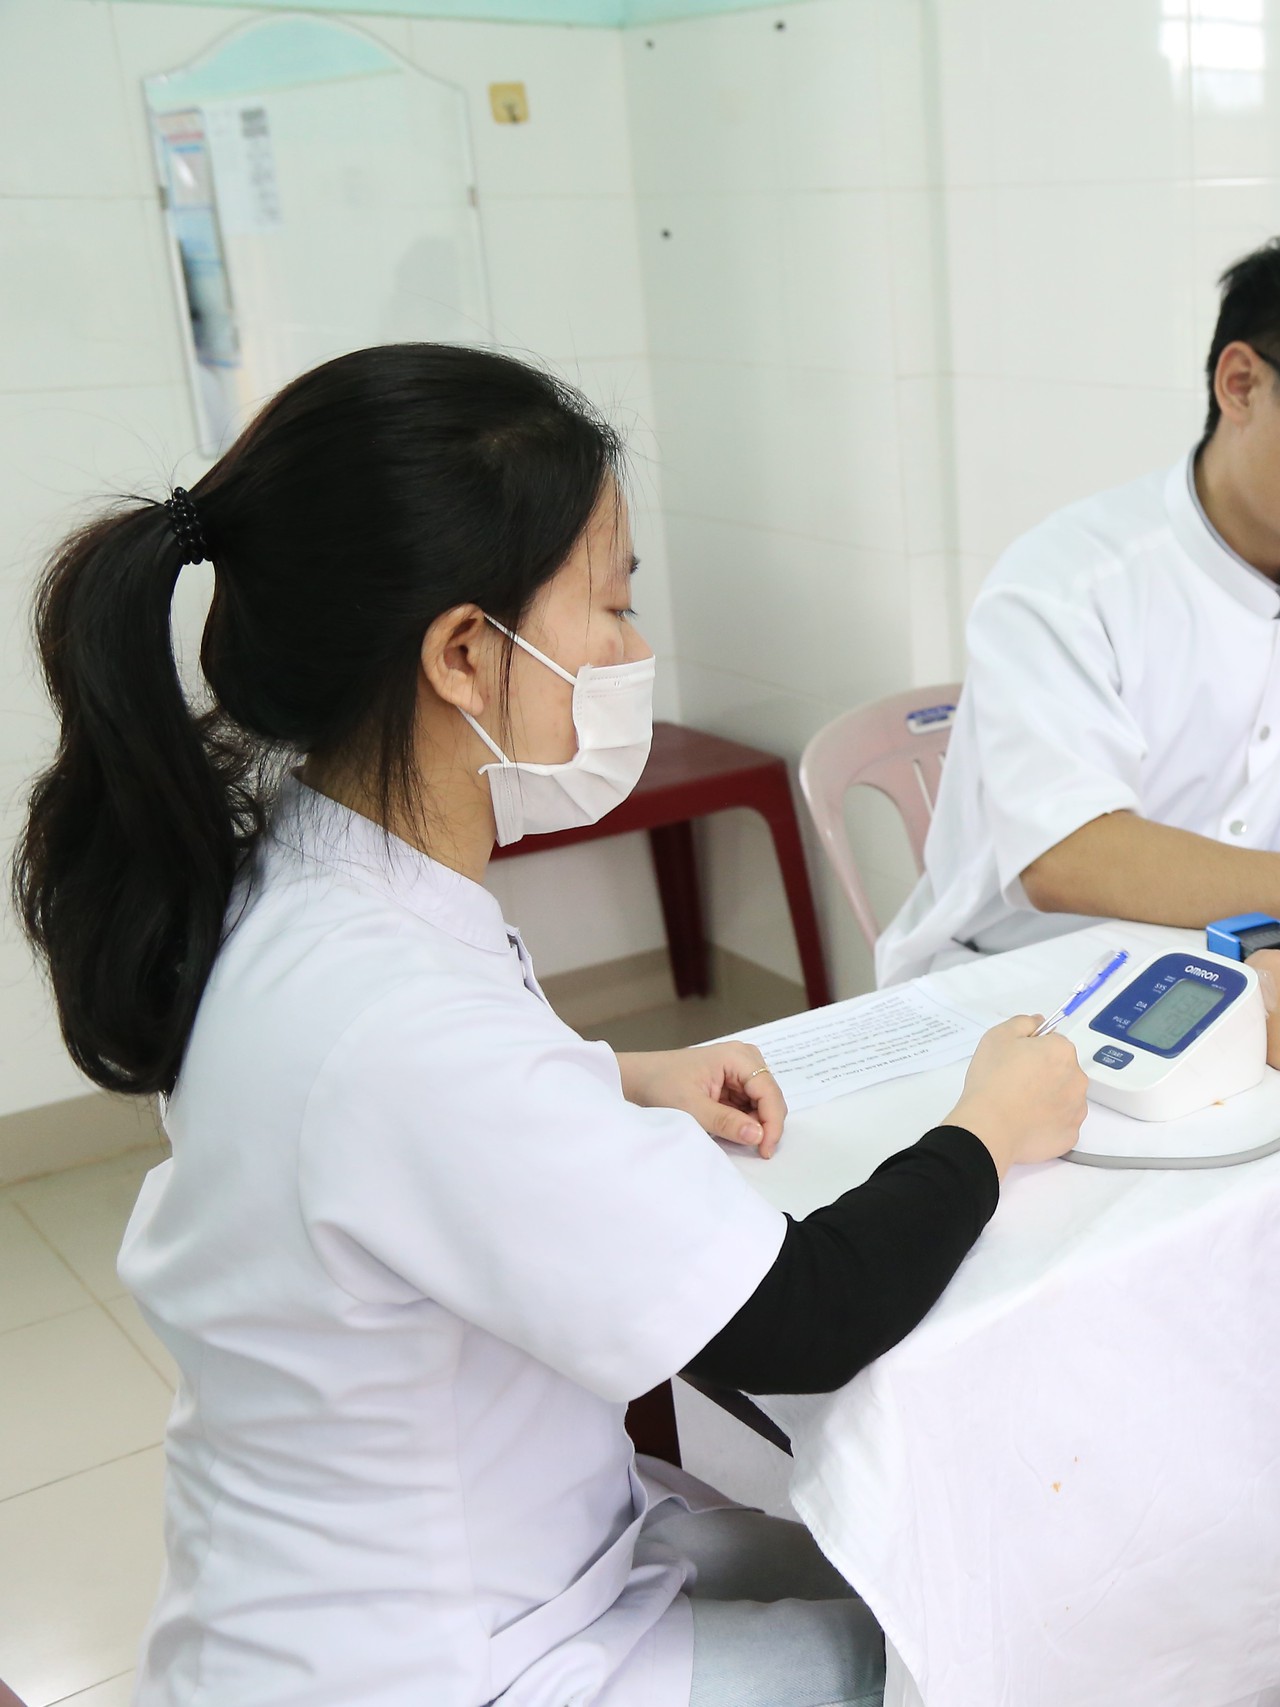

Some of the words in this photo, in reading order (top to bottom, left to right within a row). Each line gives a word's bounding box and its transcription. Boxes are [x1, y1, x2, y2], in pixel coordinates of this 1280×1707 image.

[1184, 965, 1220, 982] OMRON
[1154, 983, 1167, 991] SYS
[1136, 1001, 1148, 1009] DIA
[1113, 1015, 1131, 1026] PULSE
